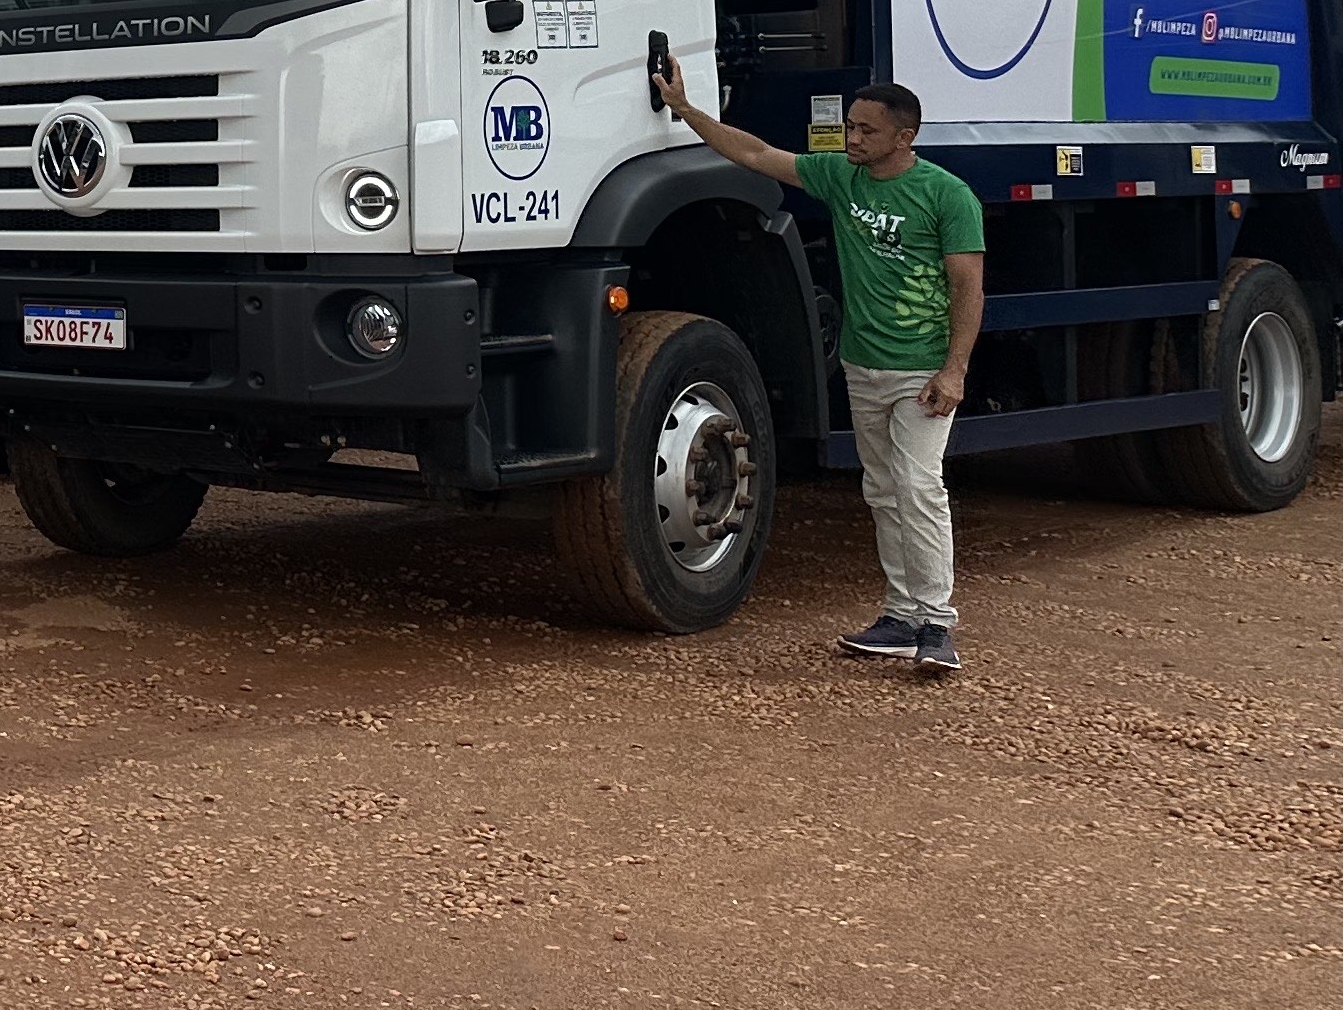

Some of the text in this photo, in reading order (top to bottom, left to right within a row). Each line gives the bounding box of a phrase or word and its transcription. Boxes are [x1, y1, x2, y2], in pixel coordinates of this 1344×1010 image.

[481, 49, 539, 65] 18.260
[491, 106, 544, 142] MB
[471, 189, 560, 223] VCL-241
